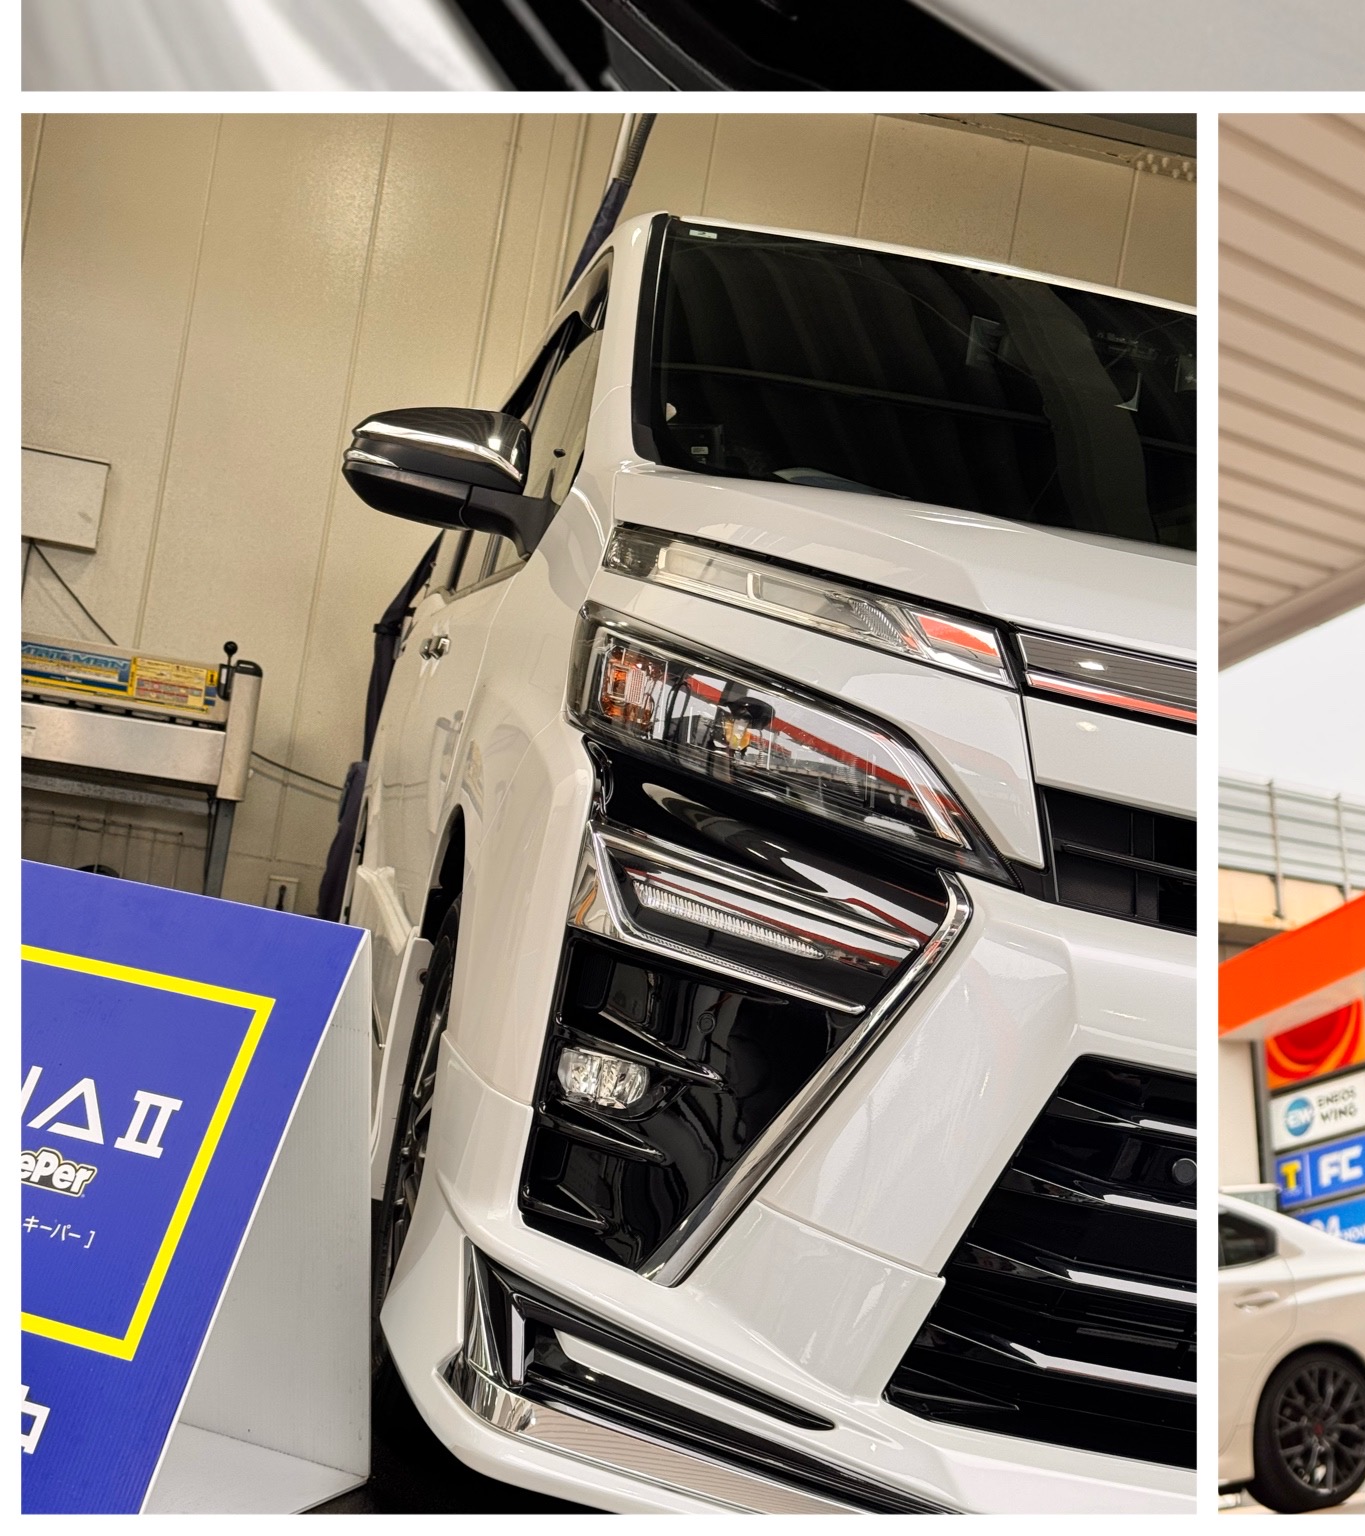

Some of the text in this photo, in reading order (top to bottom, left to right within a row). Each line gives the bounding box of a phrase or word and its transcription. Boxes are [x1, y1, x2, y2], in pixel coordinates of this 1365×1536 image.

[21, 1065, 104, 1145] IA
[1317, 1086, 1358, 1107] ENEOS
[1320, 1104, 1358, 1123] WING
[21, 1149, 96, 1195] ePer
[1319, 1145, 1363, 1188] FC
